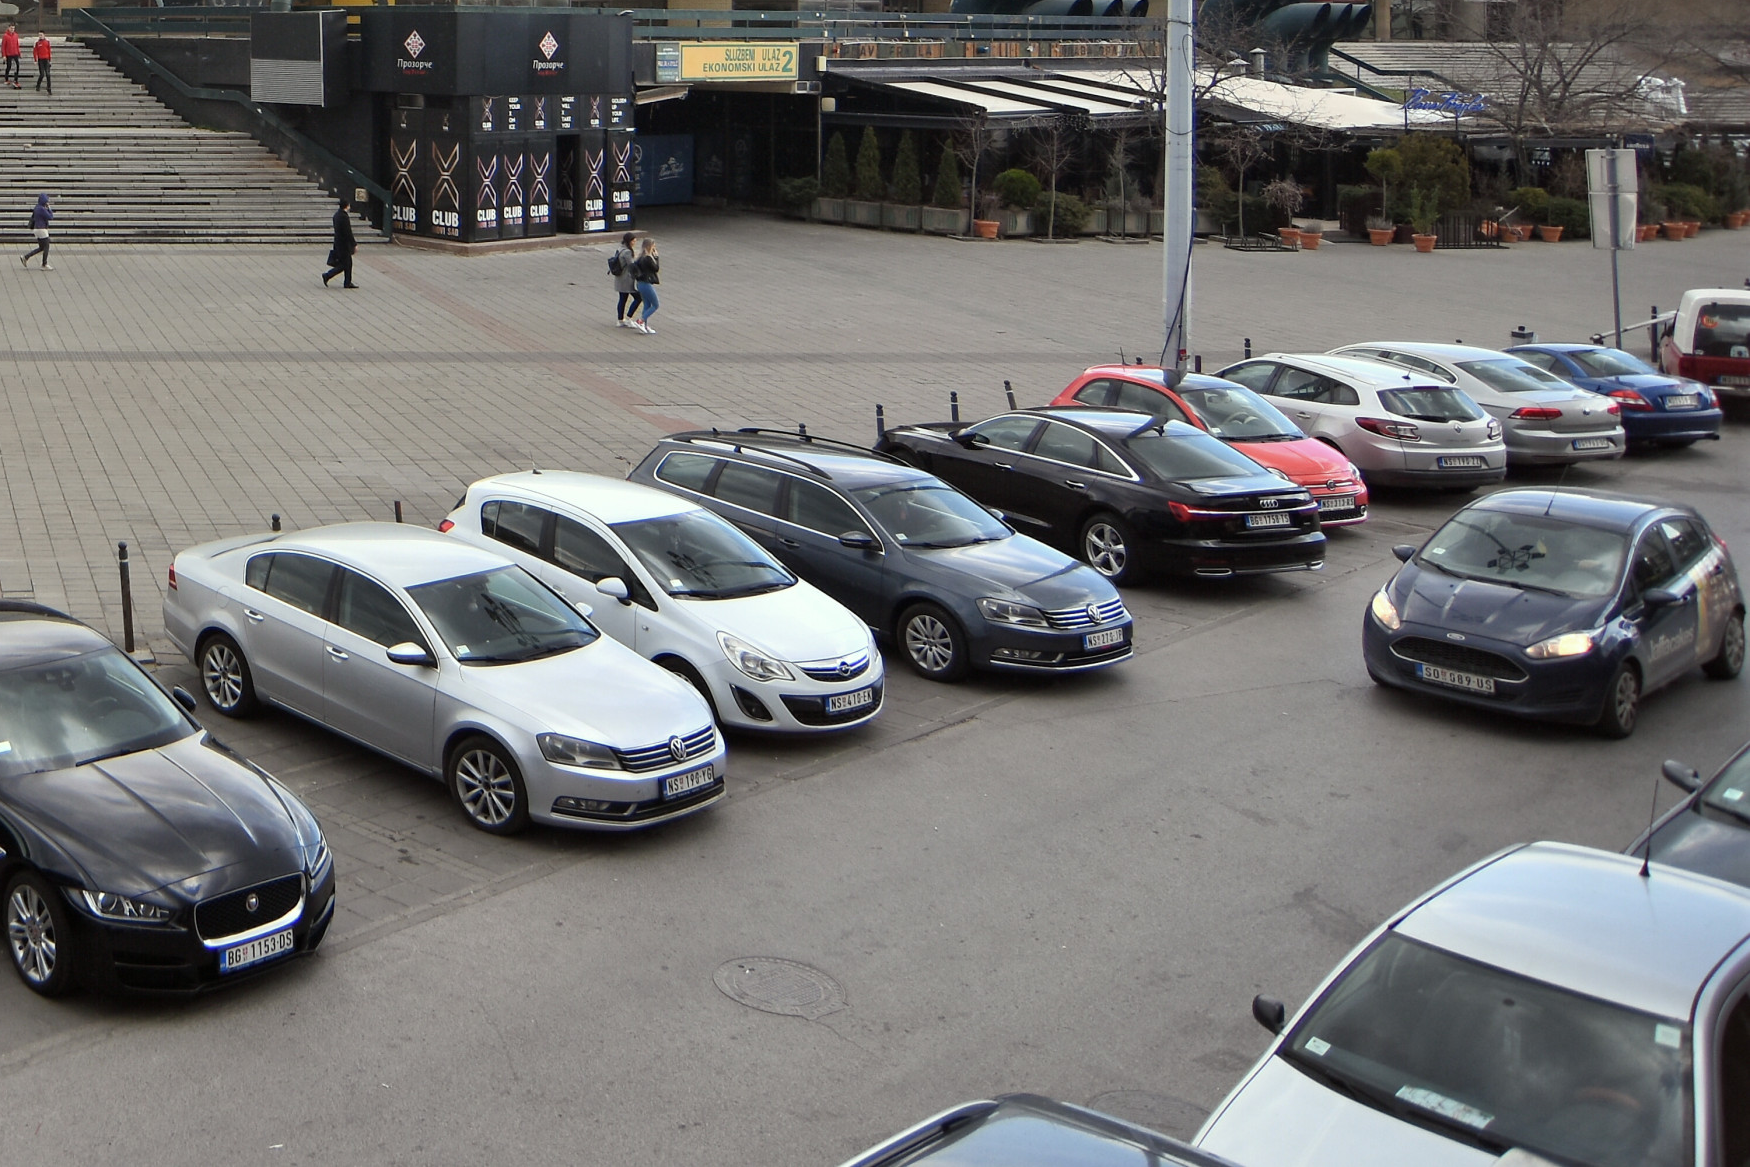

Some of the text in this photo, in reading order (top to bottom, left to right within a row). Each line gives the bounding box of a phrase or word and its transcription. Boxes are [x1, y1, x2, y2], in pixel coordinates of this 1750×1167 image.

[762, 48, 781, 62] ULAZ
[781, 50, 794, 73] 2
[397, 58, 433, 70] Прозорче
[532, 59, 564, 71] Прозорче
[703, 62, 781, 73] EKONOMSKI ULAZ
[613, 191, 630, 203] CLUB
[530, 204, 549, 217] CLUB
[585, 199, 603, 211] CLUB
[432, 209, 459, 227] CLUB
[477, 208, 497, 222] CLUB
[503, 206, 523, 218] CLUB
[447, 228, 459, 236] SAD
[1250, 514, 1260, 526] BG
[1088, 634, 1097, 647] NS
[1425, 666, 1440, 679] SO
[831, 697, 842, 710] NS
[667, 778, 679, 794] NS
[228, 948, 242, 966] BG
